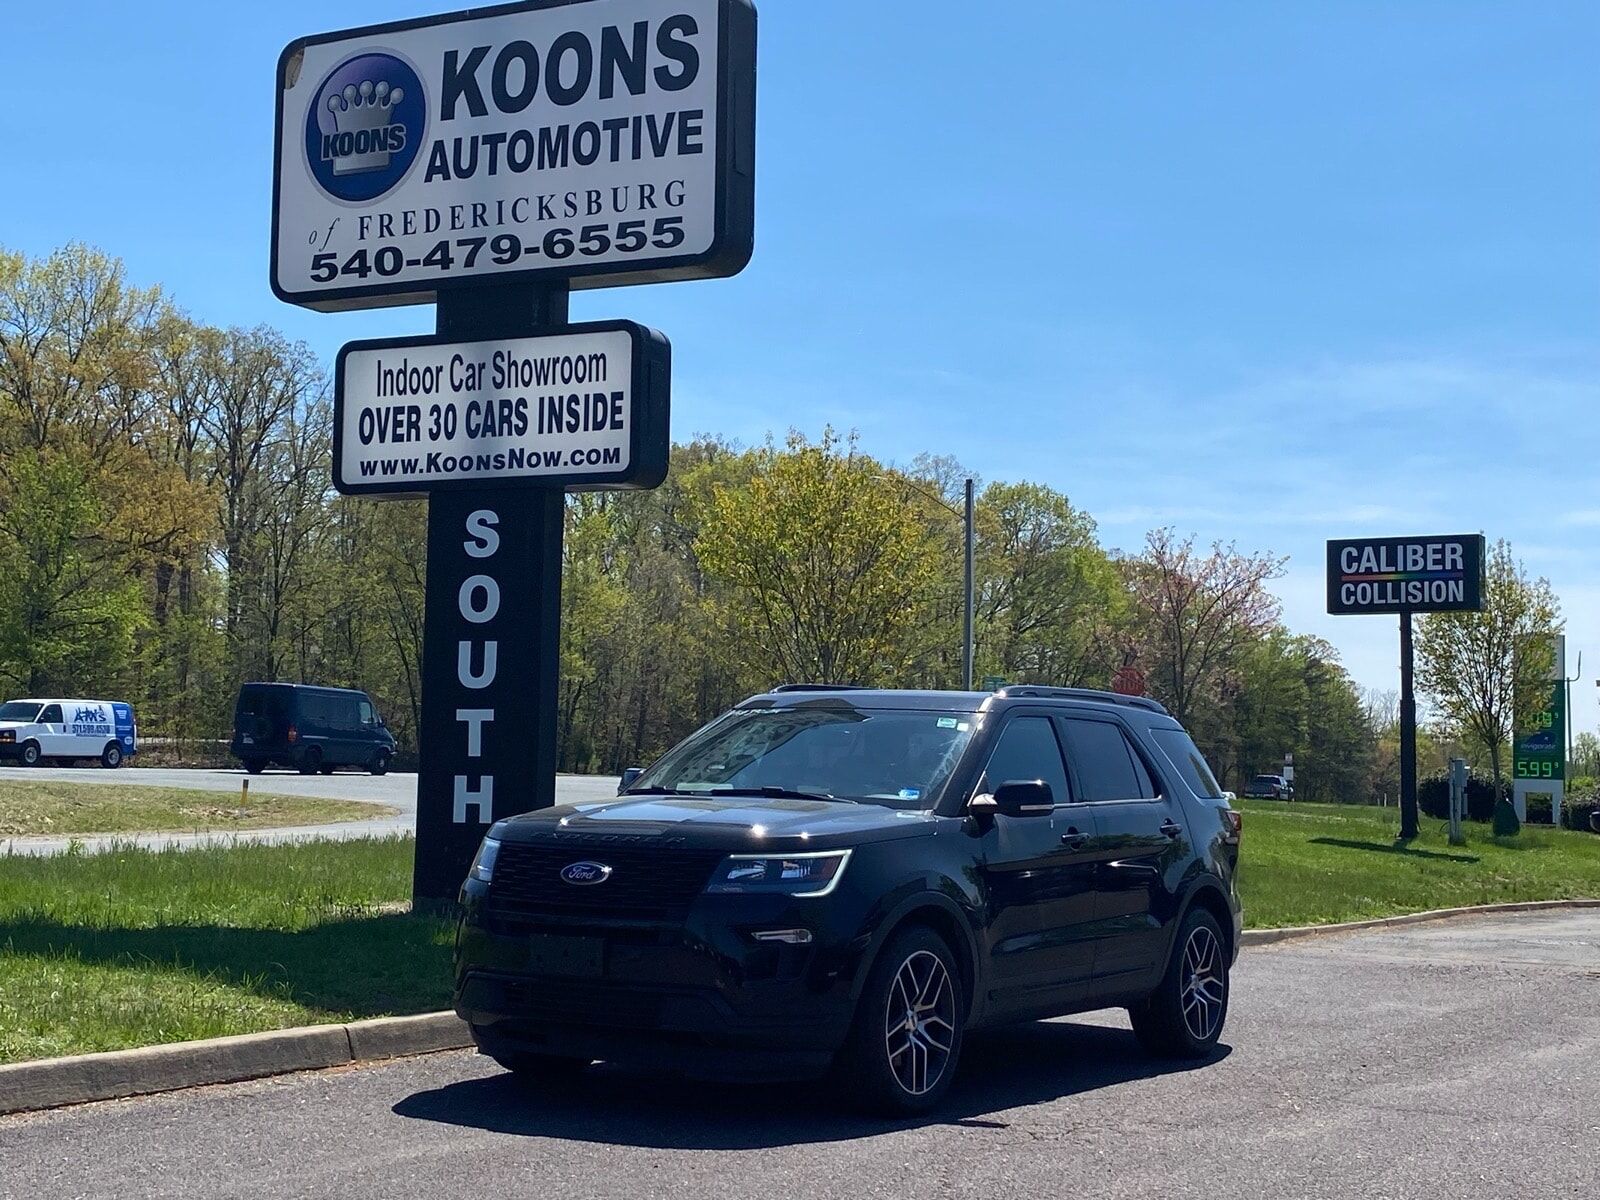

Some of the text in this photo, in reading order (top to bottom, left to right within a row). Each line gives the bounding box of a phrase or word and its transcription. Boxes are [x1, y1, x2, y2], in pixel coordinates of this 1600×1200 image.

[439, 14, 701, 122] KOONS
[321, 123, 406, 161] KOONS
[423, 108, 704, 183] AUTOMOTIVE
[308, 179, 687, 253] of FREDERICKSBURG
[310, 216, 686, 283] 540-479-6555
[376, 350, 607, 397] Indoor Car Showroom
[358, 391, 624, 446] OVER 30 CARS INSIDE
[1340, 543, 1464, 574] CALIBER
[1340, 580, 1464, 606] COLLISION
[453, 509, 500, 824] SOUTH
[568, 865, 596, 880] Ford
